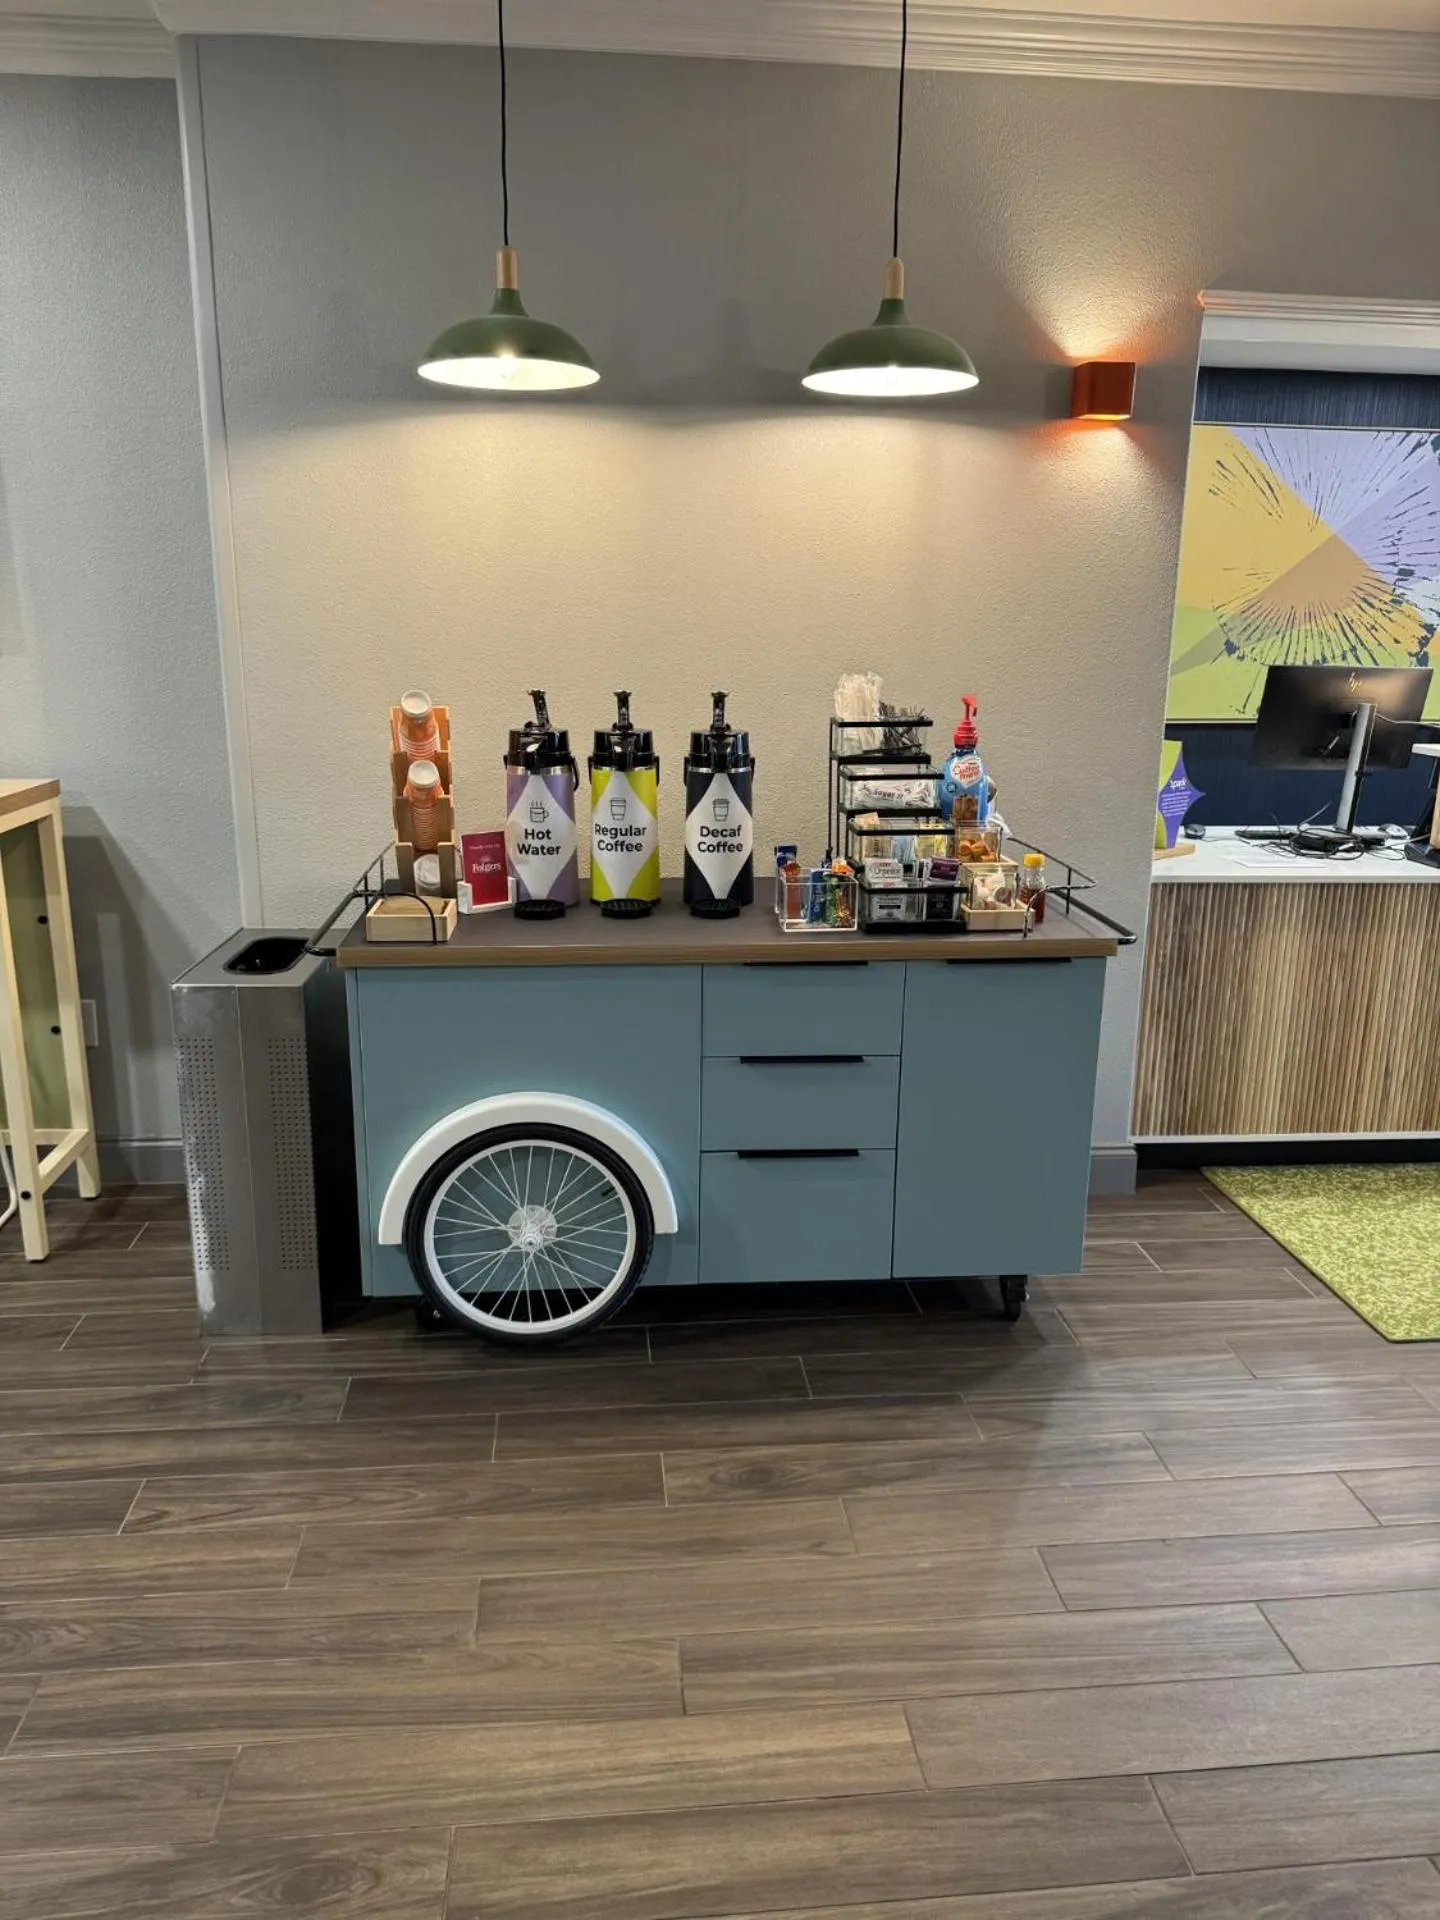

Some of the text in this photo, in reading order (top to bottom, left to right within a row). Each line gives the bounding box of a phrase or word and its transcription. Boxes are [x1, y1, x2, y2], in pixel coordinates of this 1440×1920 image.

[524, 828, 552, 840] Hot
[594, 823, 647, 839] Regular
[700, 824, 742, 838] Decaf
[516, 843, 561, 856] Water
[597, 839, 643, 852] Coffee
[697, 841, 743, 853] Coffee
